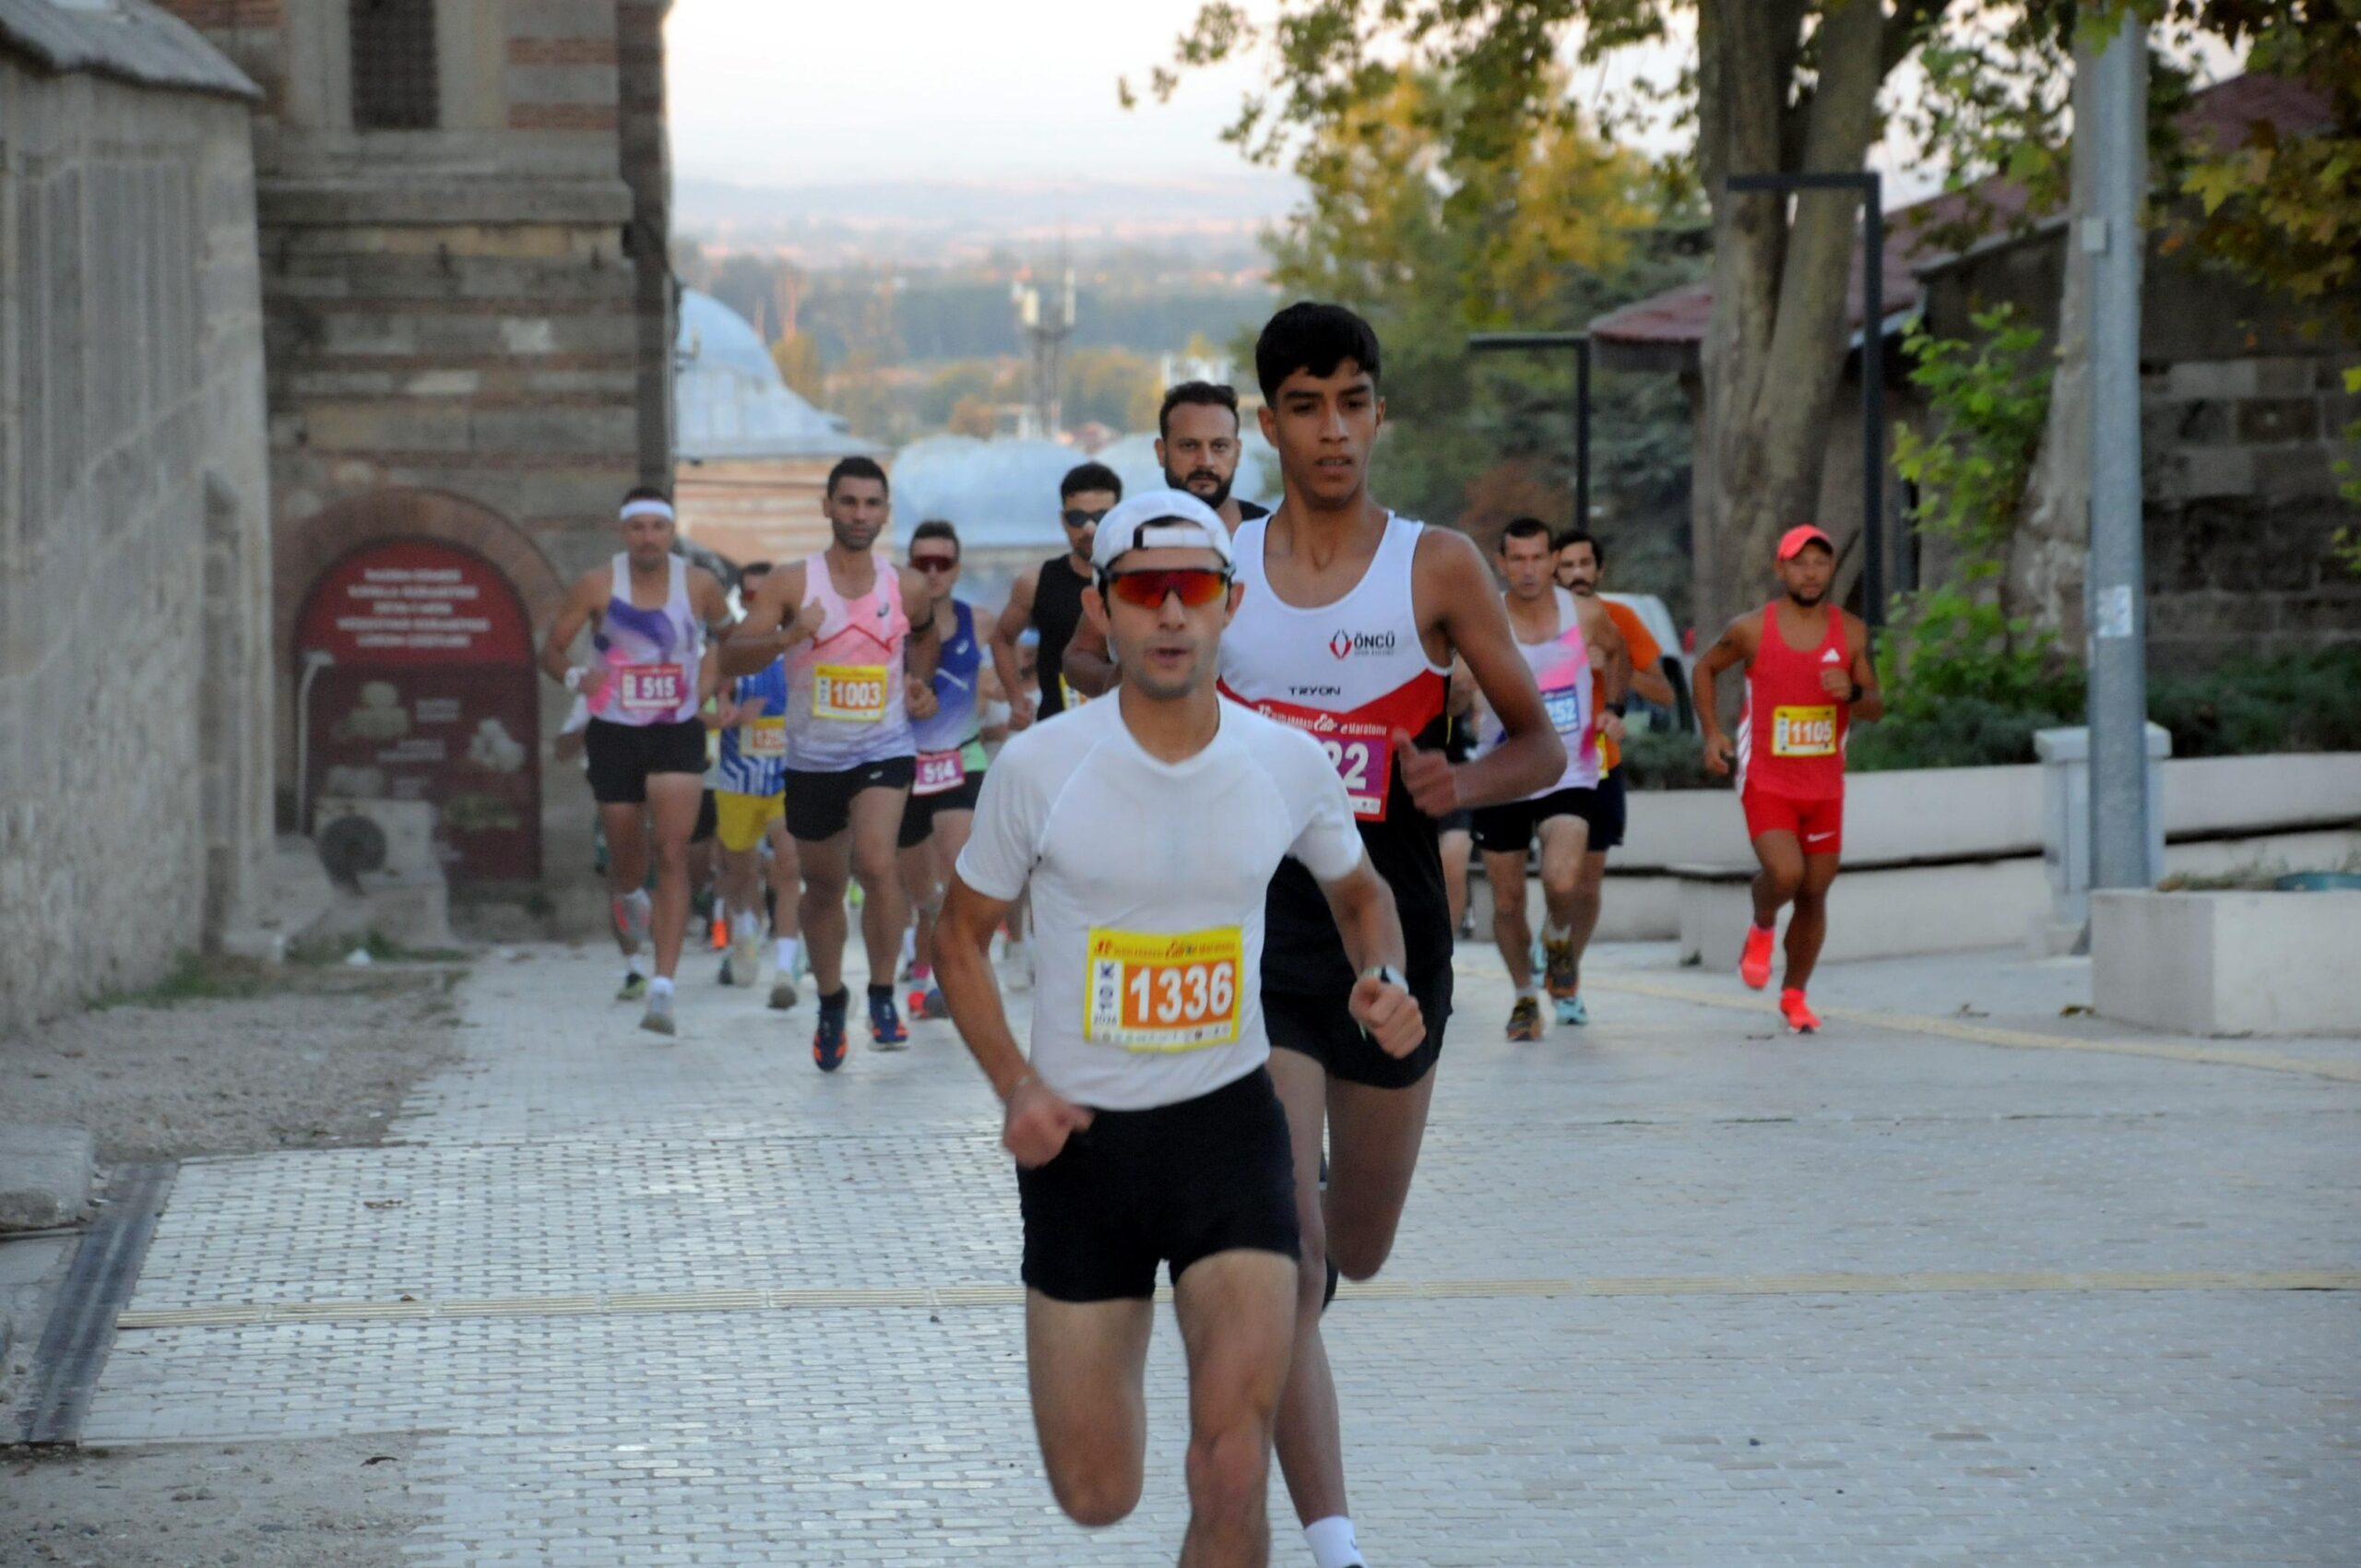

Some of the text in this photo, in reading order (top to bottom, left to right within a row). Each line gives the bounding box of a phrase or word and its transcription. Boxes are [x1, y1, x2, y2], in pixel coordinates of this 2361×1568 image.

[1354, 630, 1395, 649] ÖNCÜ
[641, 675, 676, 698] 515
[833, 680, 881, 707] 1003
[1288, 684, 1341, 696] TRYON
[1791, 719, 1832, 743] 1105
[923, 758, 956, 783] 514
[1130, 961, 1234, 1024] 1336
